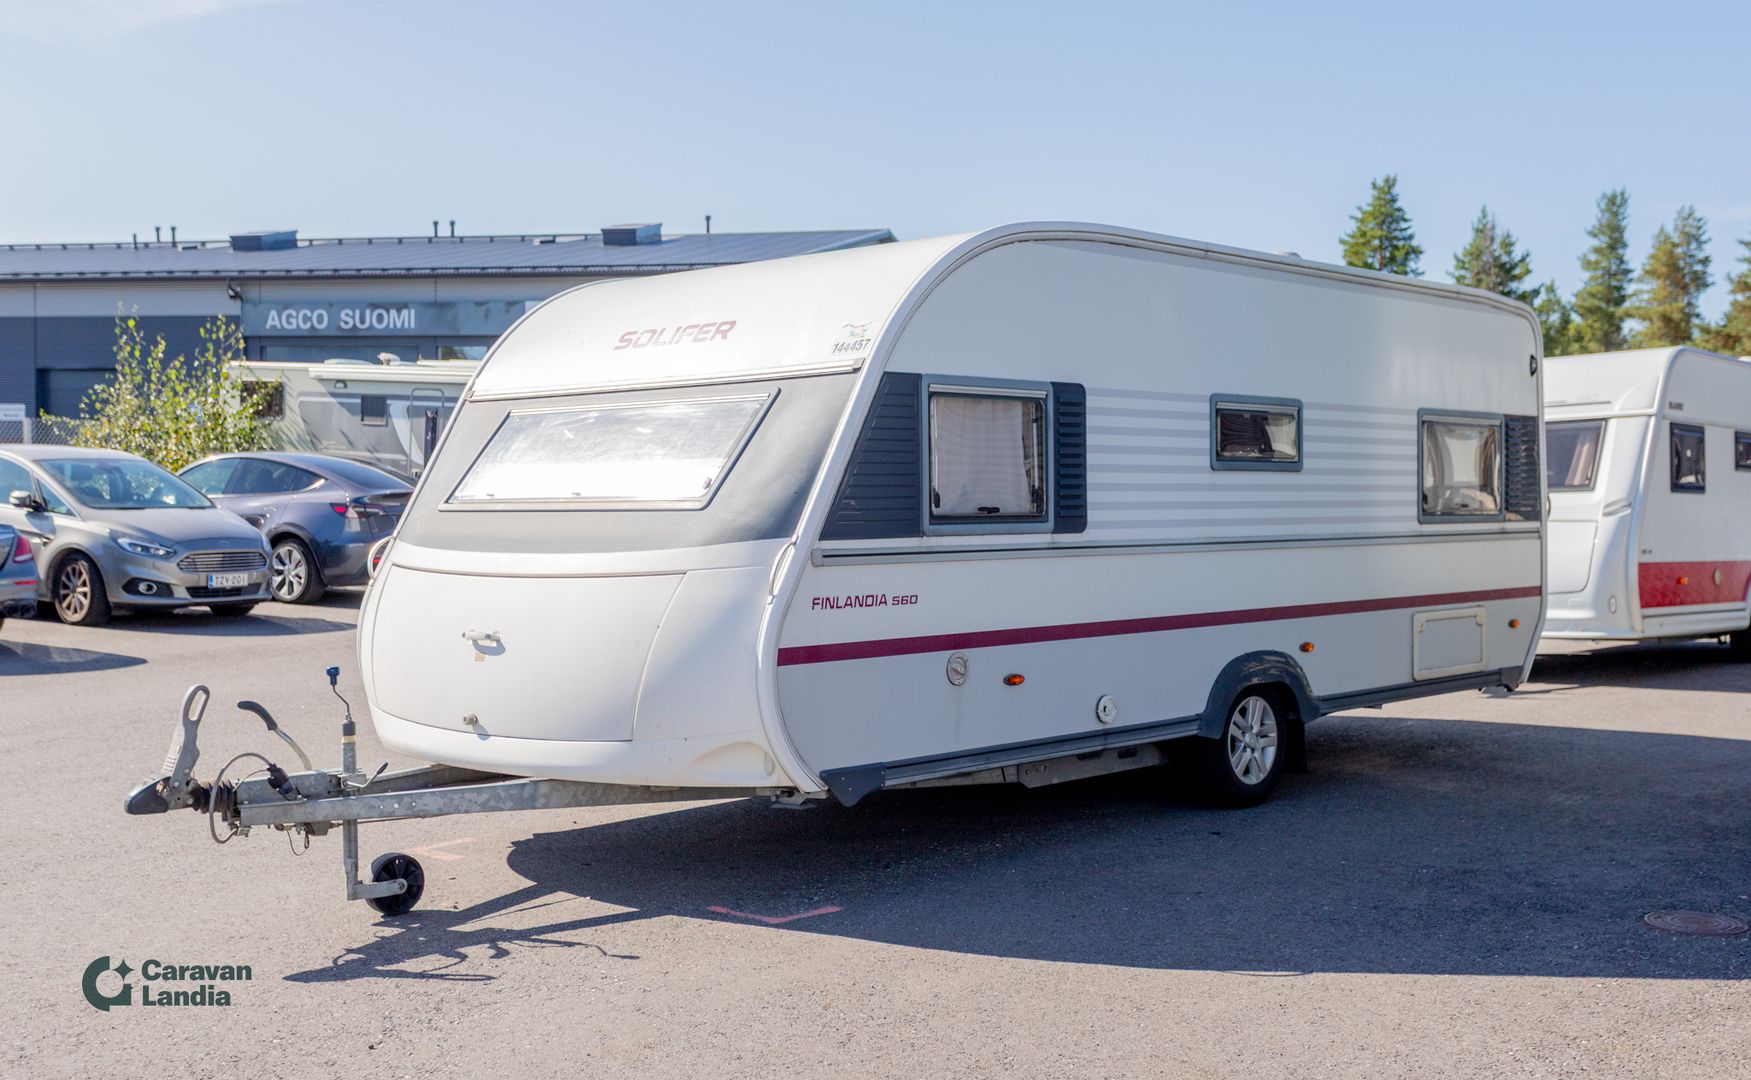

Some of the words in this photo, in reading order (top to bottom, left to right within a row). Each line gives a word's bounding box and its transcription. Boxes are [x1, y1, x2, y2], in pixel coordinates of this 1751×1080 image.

[265, 308, 329, 330] AGCO
[339, 308, 416, 330] SUOMI
[613, 320, 737, 351] SOLIFER
[811, 593, 888, 611] FINLANDIA
[892, 594, 919, 606] 560
